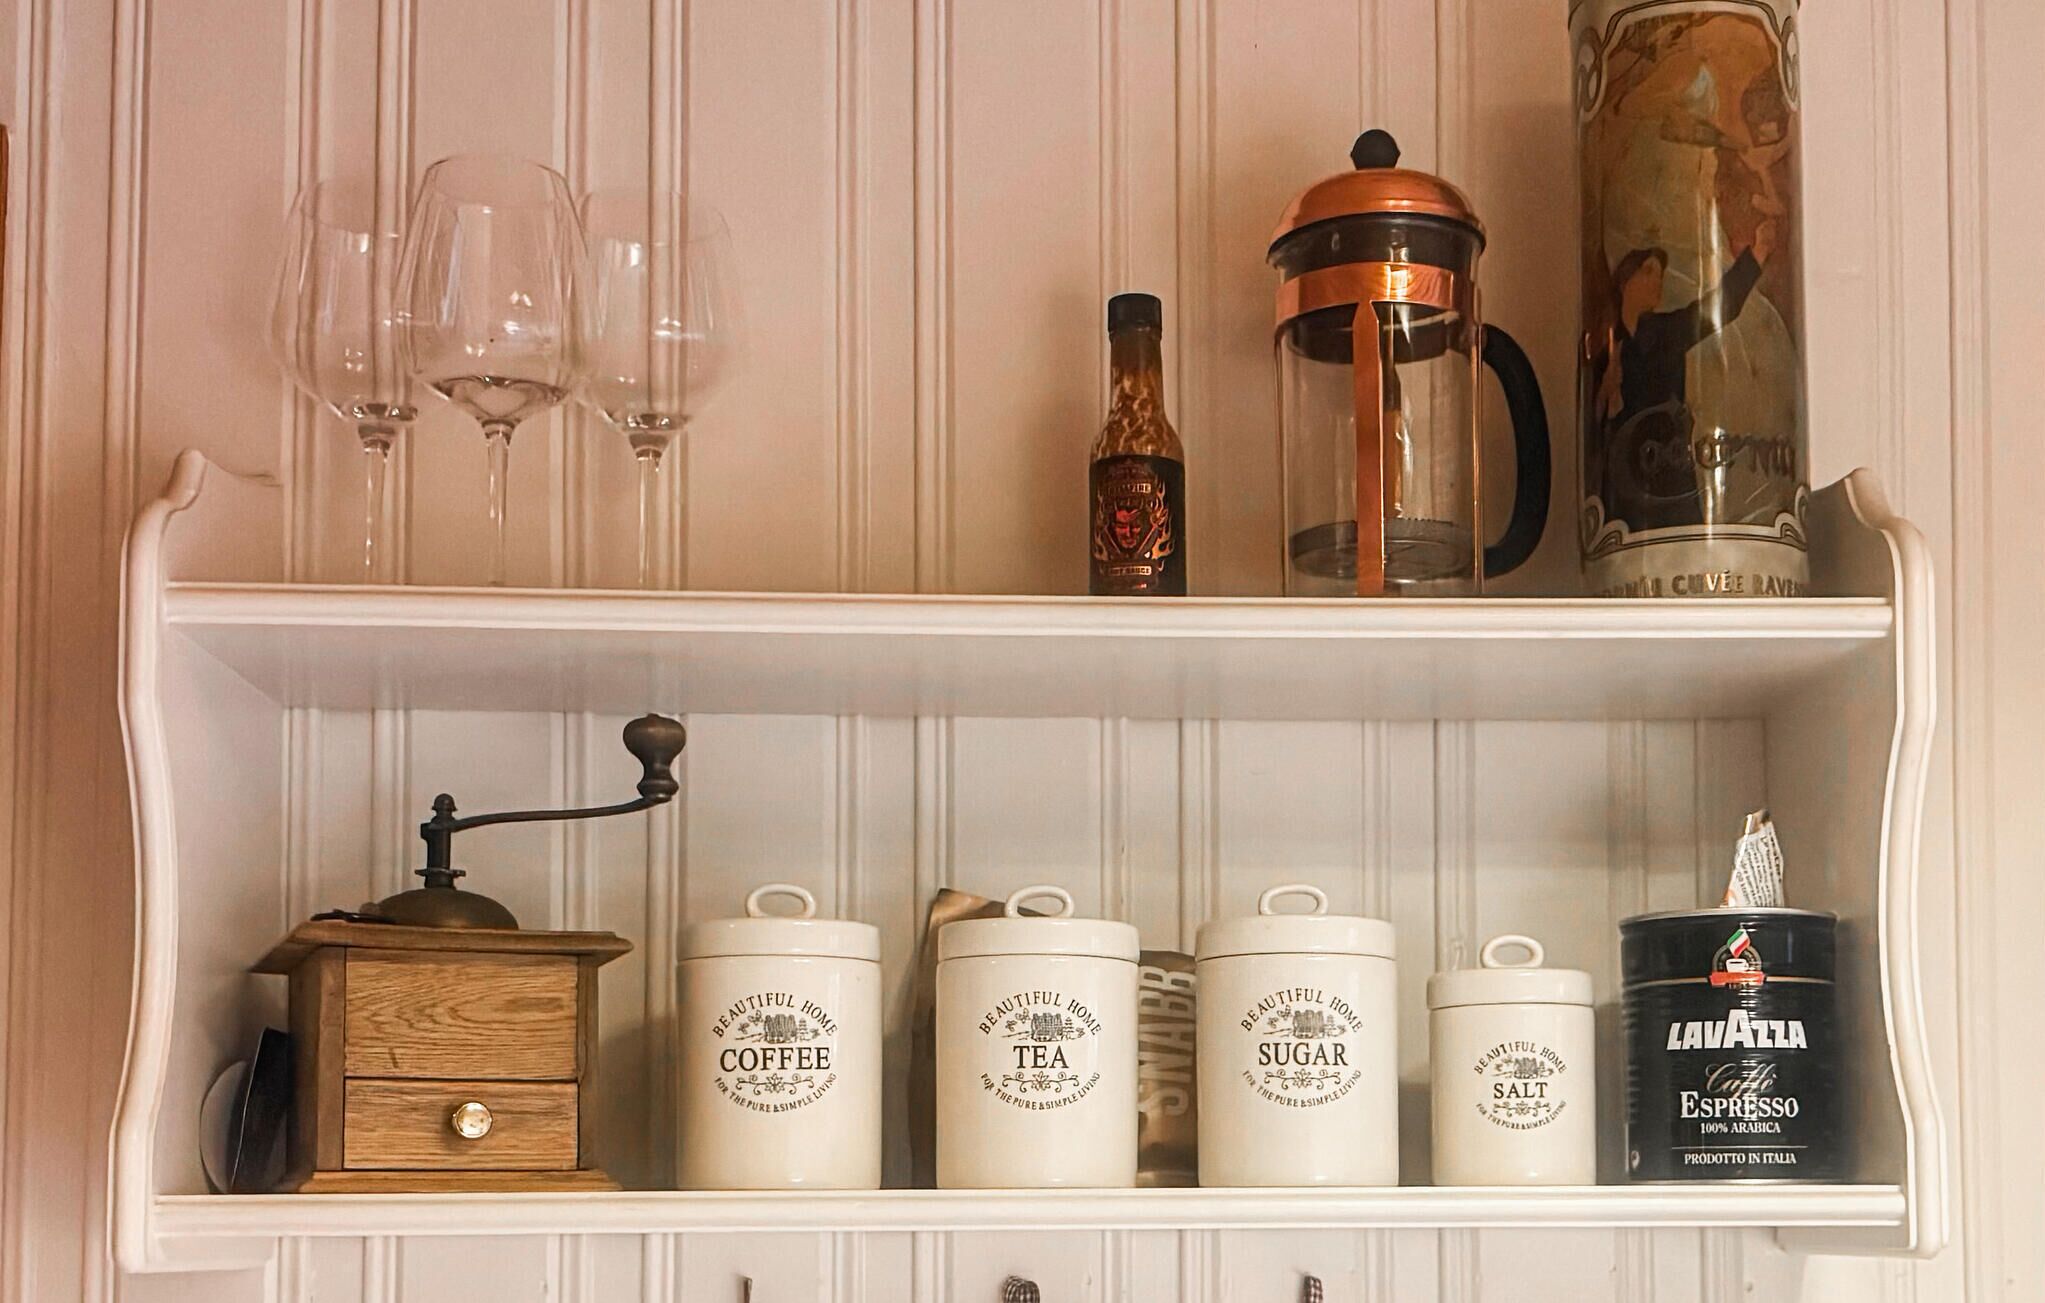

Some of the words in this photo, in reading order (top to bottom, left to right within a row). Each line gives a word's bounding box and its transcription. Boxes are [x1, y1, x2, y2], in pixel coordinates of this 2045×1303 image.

[1672, 569, 1744, 595] CUVÉE
[713, 993, 794, 1038] BEAUTIFUL
[801, 1000, 838, 1036] HOME
[979, 991, 1061, 1034] BEAUTIFUL
[1067, 999, 1101, 1035] HOME
[1241, 988, 1323, 1031] BEAUTIFUL
[1329, 996, 1363, 1033] HOME
[1666, 1008, 1808, 1050] LAVAZZA
[720, 1047, 831, 1072] COFFEE
[1013, 1045, 1069, 1068] TEA
[1259, 1042, 1348, 1066] SUGAR
[1474, 1041, 1536, 1074] BEAUTIFUL
[1540, 1047, 1567, 1074] HOME
[714, 1076, 729, 1094] FOR
[729, 1091, 745, 1106] THE
[747, 1099, 770, 1112] PURE
[813, 1073, 837, 1099] LIVING
[981, 1073, 994, 1090] FOR
[995, 1088, 1012, 1103] THE
[1013, 1097, 1036, 1110] PURE
[1078, 1073, 1101, 1098] LIVING
[1243, 1070, 1256, 1087] FOR
[1257, 1086, 1274, 1101] THE
[1274, 1094, 1298, 1108] PURE
[1340, 1070, 1361, 1096] LIVING
[1494, 1082, 1548, 1099] SALT
[1700, 1122, 1728, 1134] 100%
[1731, 1121, 1781, 1134] ARABICA
[1684, 1152, 1745, 1165] PRODOTTO
[1748, 1152, 1760, 1164] IN
[1763, 1152, 1797, 1164] ITALIA
